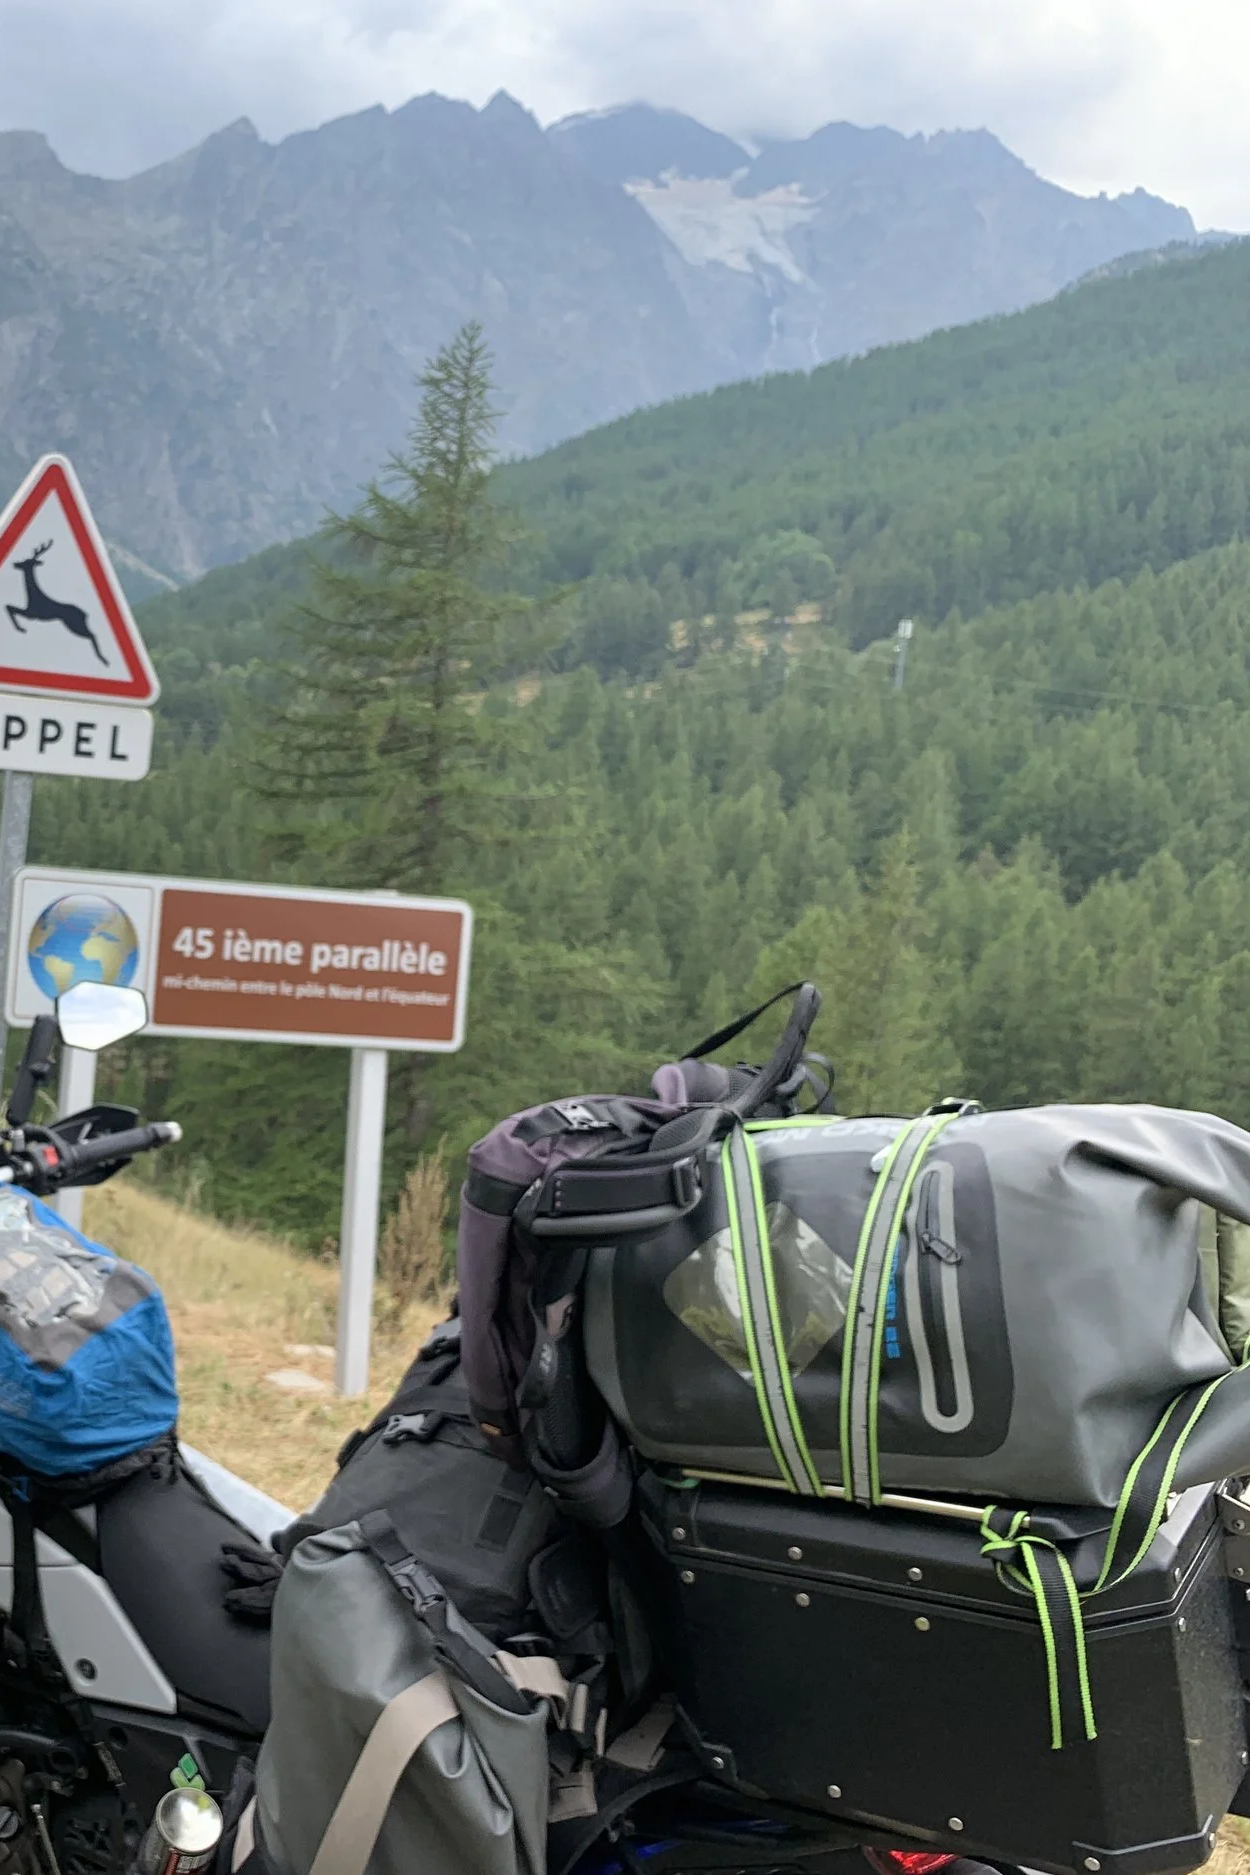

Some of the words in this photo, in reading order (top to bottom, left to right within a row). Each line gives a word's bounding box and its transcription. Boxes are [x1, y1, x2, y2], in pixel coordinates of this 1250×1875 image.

[172, 926, 215, 960] 45
[222, 927, 304, 966] ième
[310, 938, 448, 976] parallèle
[162, 973, 238, 993] mi-chemin
[240, 980, 278, 996] entre
[279, 980, 294, 997] le
[328, 983, 364, 1001] Nord
[365, 988, 380, 1003] et
